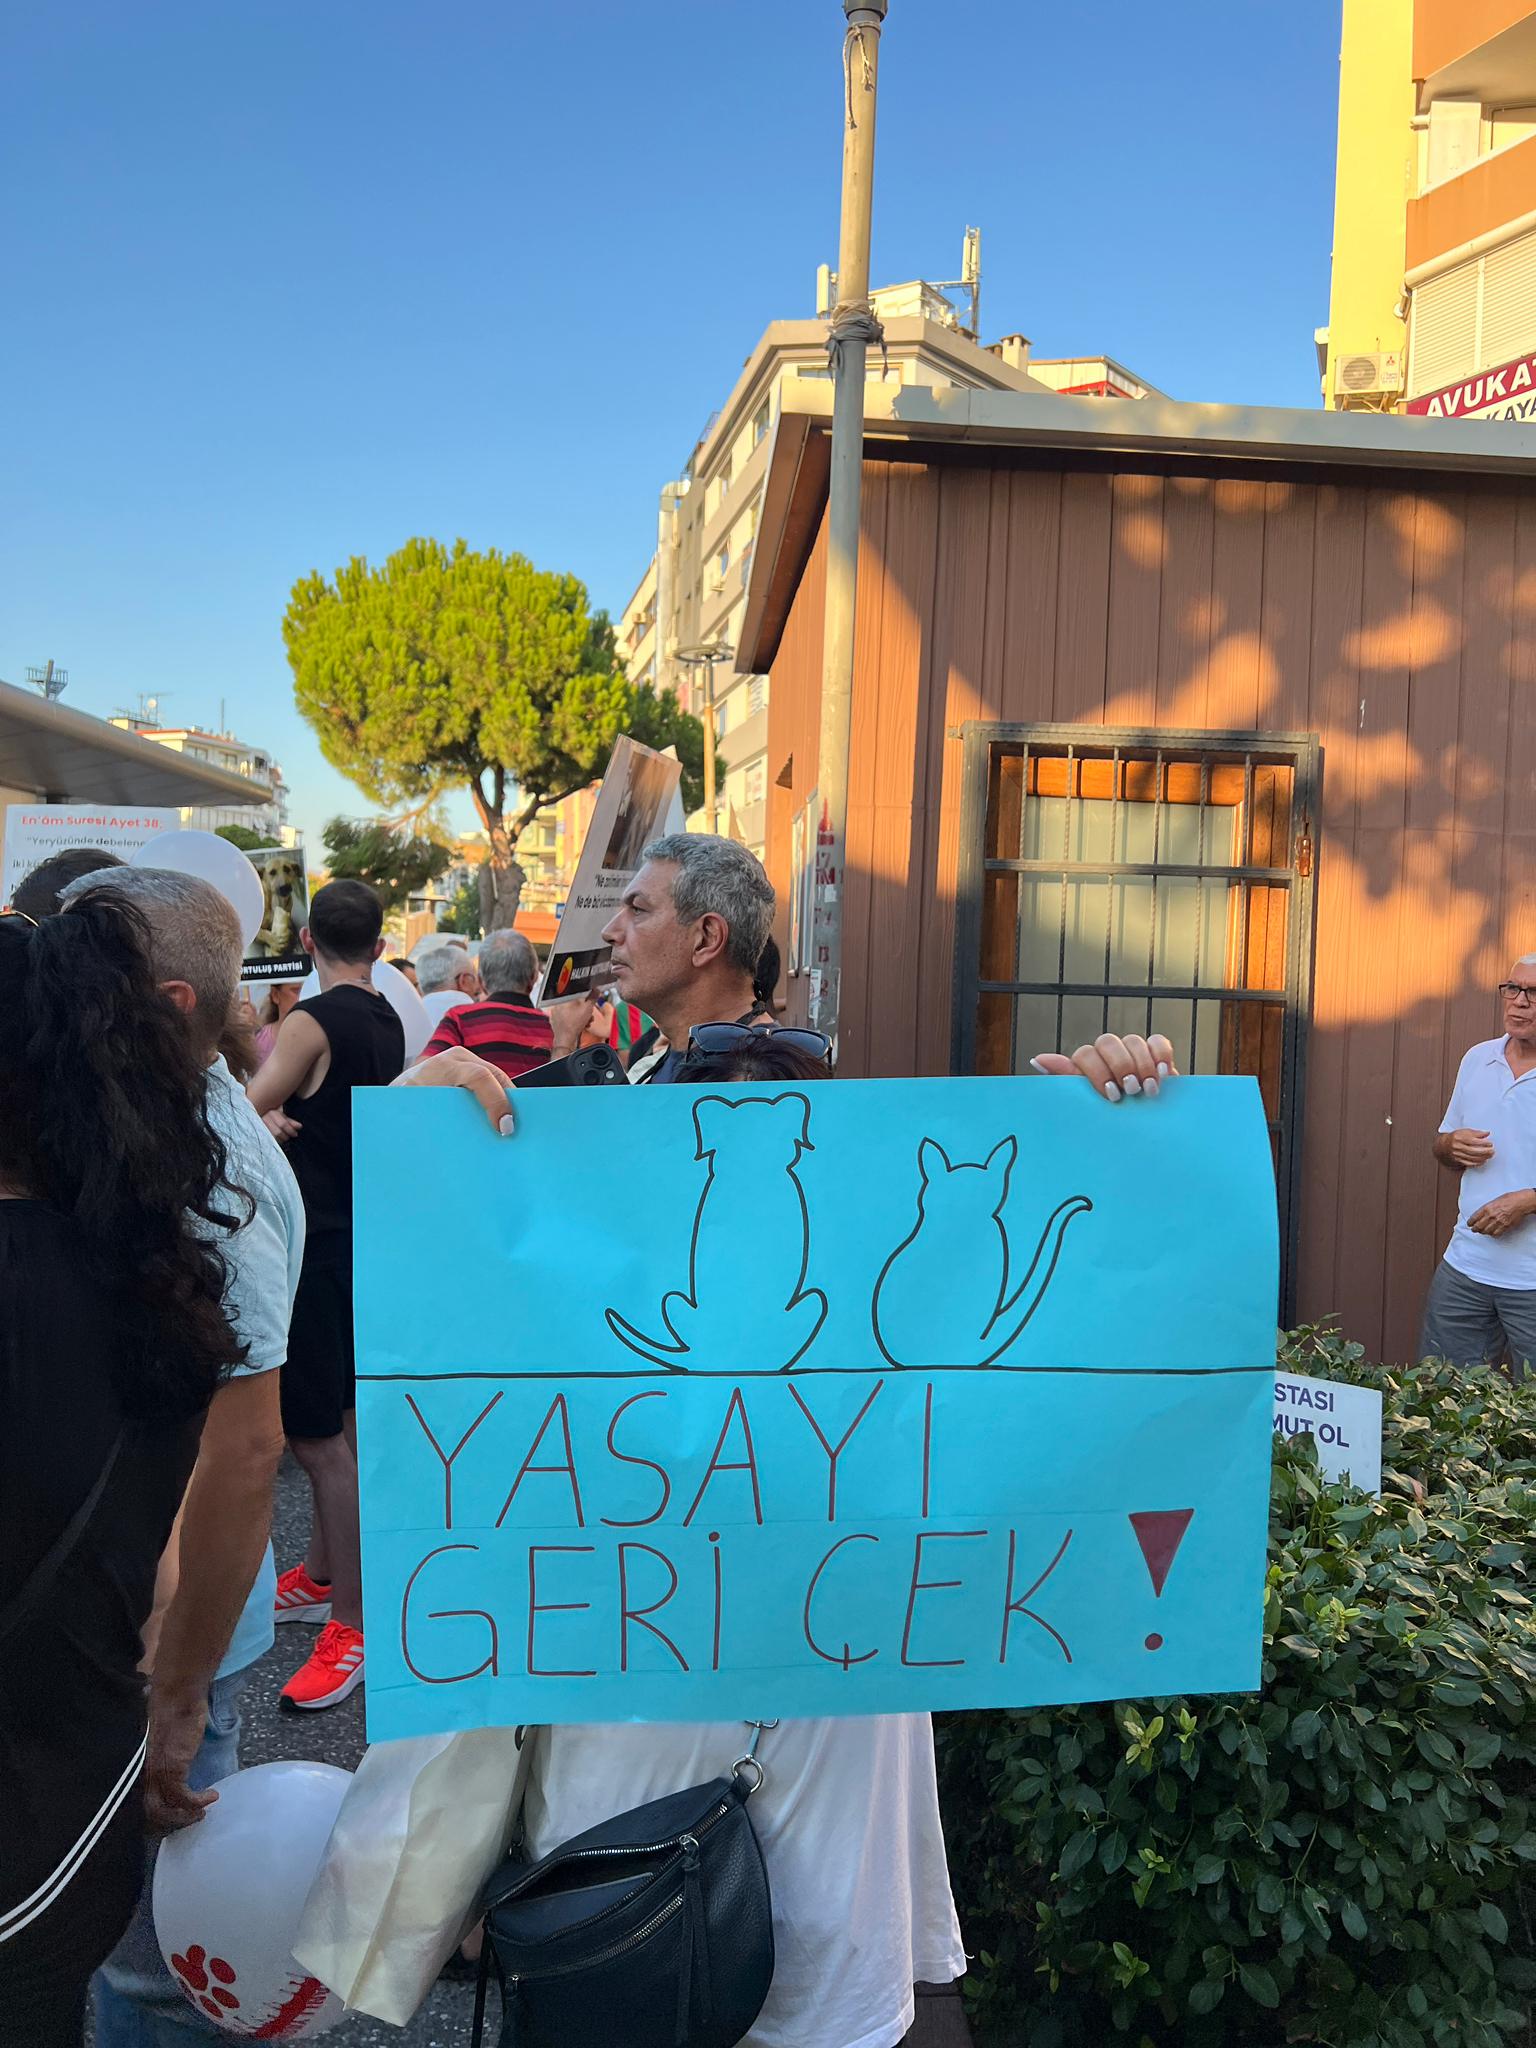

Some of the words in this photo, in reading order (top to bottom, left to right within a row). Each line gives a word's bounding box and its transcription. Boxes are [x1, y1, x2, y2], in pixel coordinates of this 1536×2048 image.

[1427, 358, 1536, 417] AVUKA
[67, 815, 107, 827] Suresi
[110, 817, 139, 830] Ayet
[241, 964, 272, 975] RTULUŞ
[404, 1379, 933, 1530] YASAYI
[1318, 1423, 1350, 1448] OL
[401, 1531, 722, 1684] GERİ
